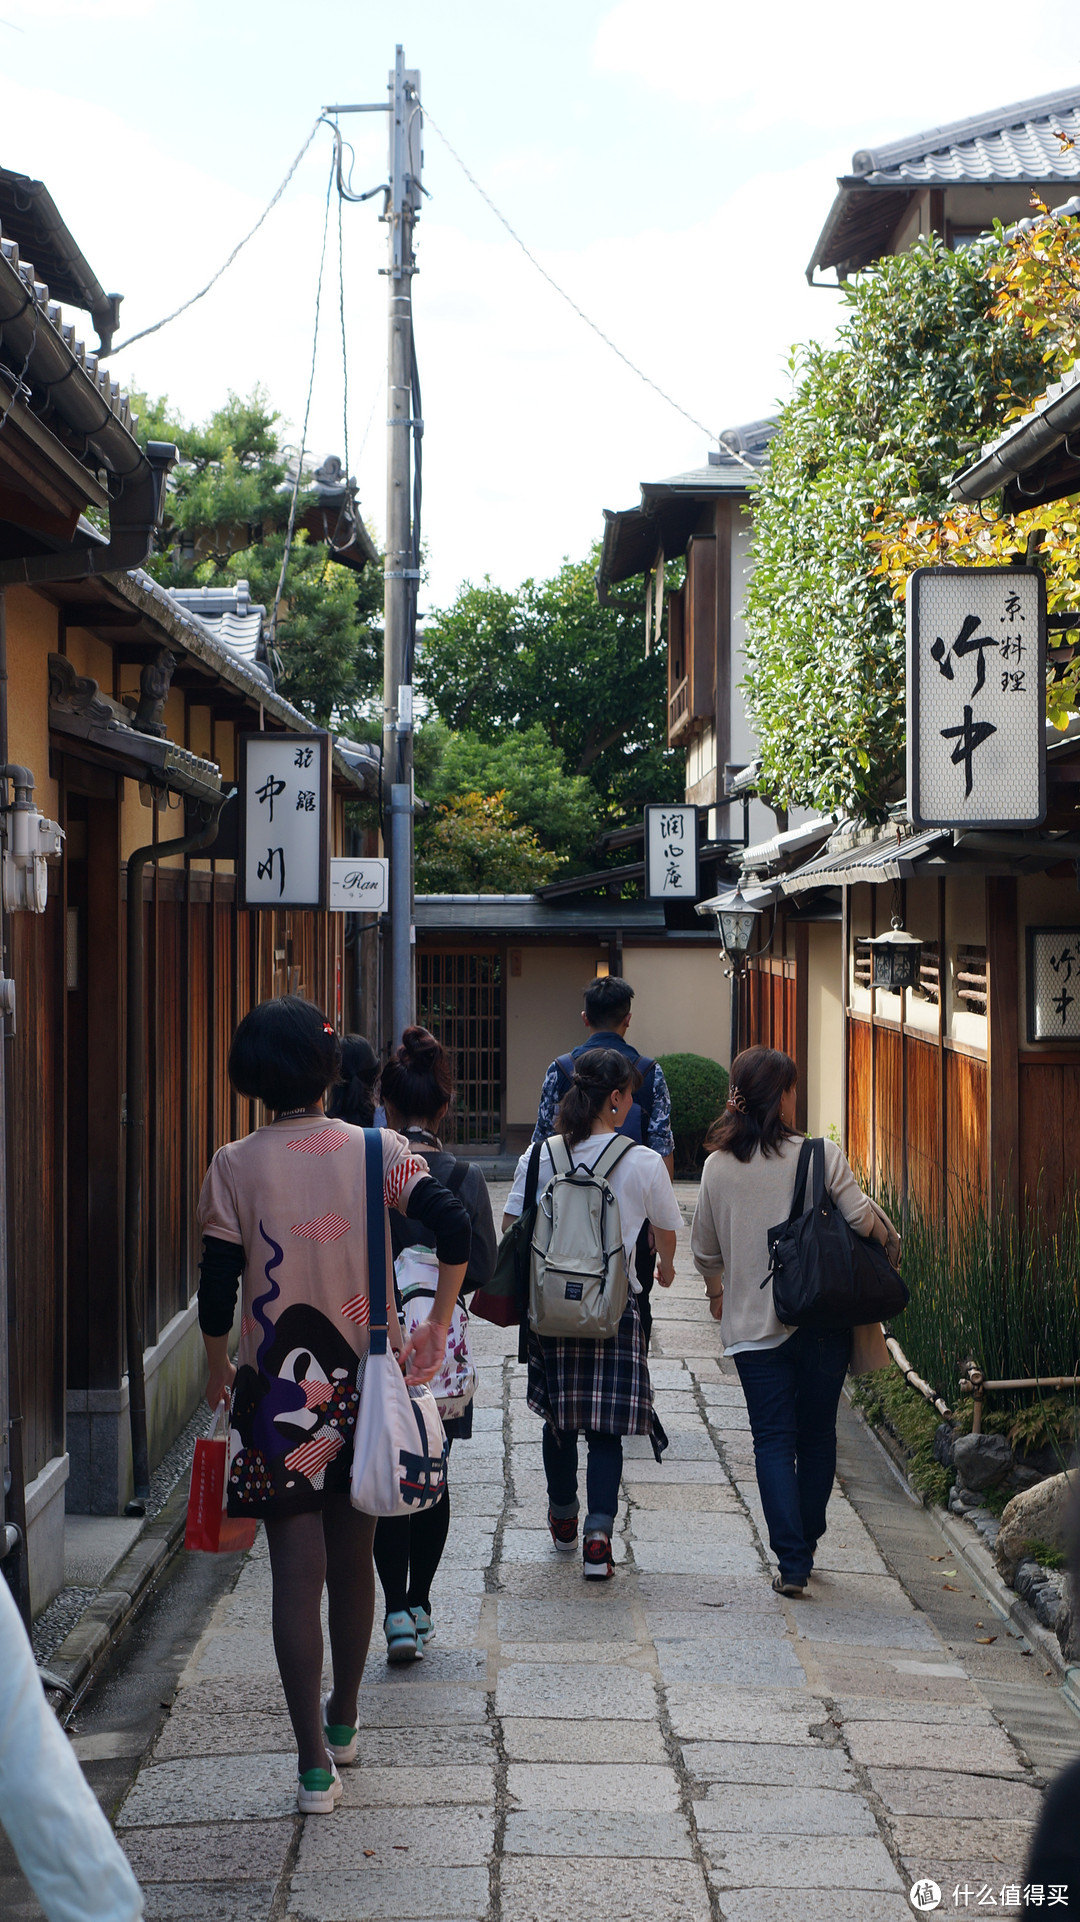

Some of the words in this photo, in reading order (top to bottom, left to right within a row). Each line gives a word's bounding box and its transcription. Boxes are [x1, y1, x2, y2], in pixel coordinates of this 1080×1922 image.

[1000, 591, 1027, 692] 京料理
[931, 614, 999, 800] 竹中
[1050, 948, 1076, 1025] 竹中
